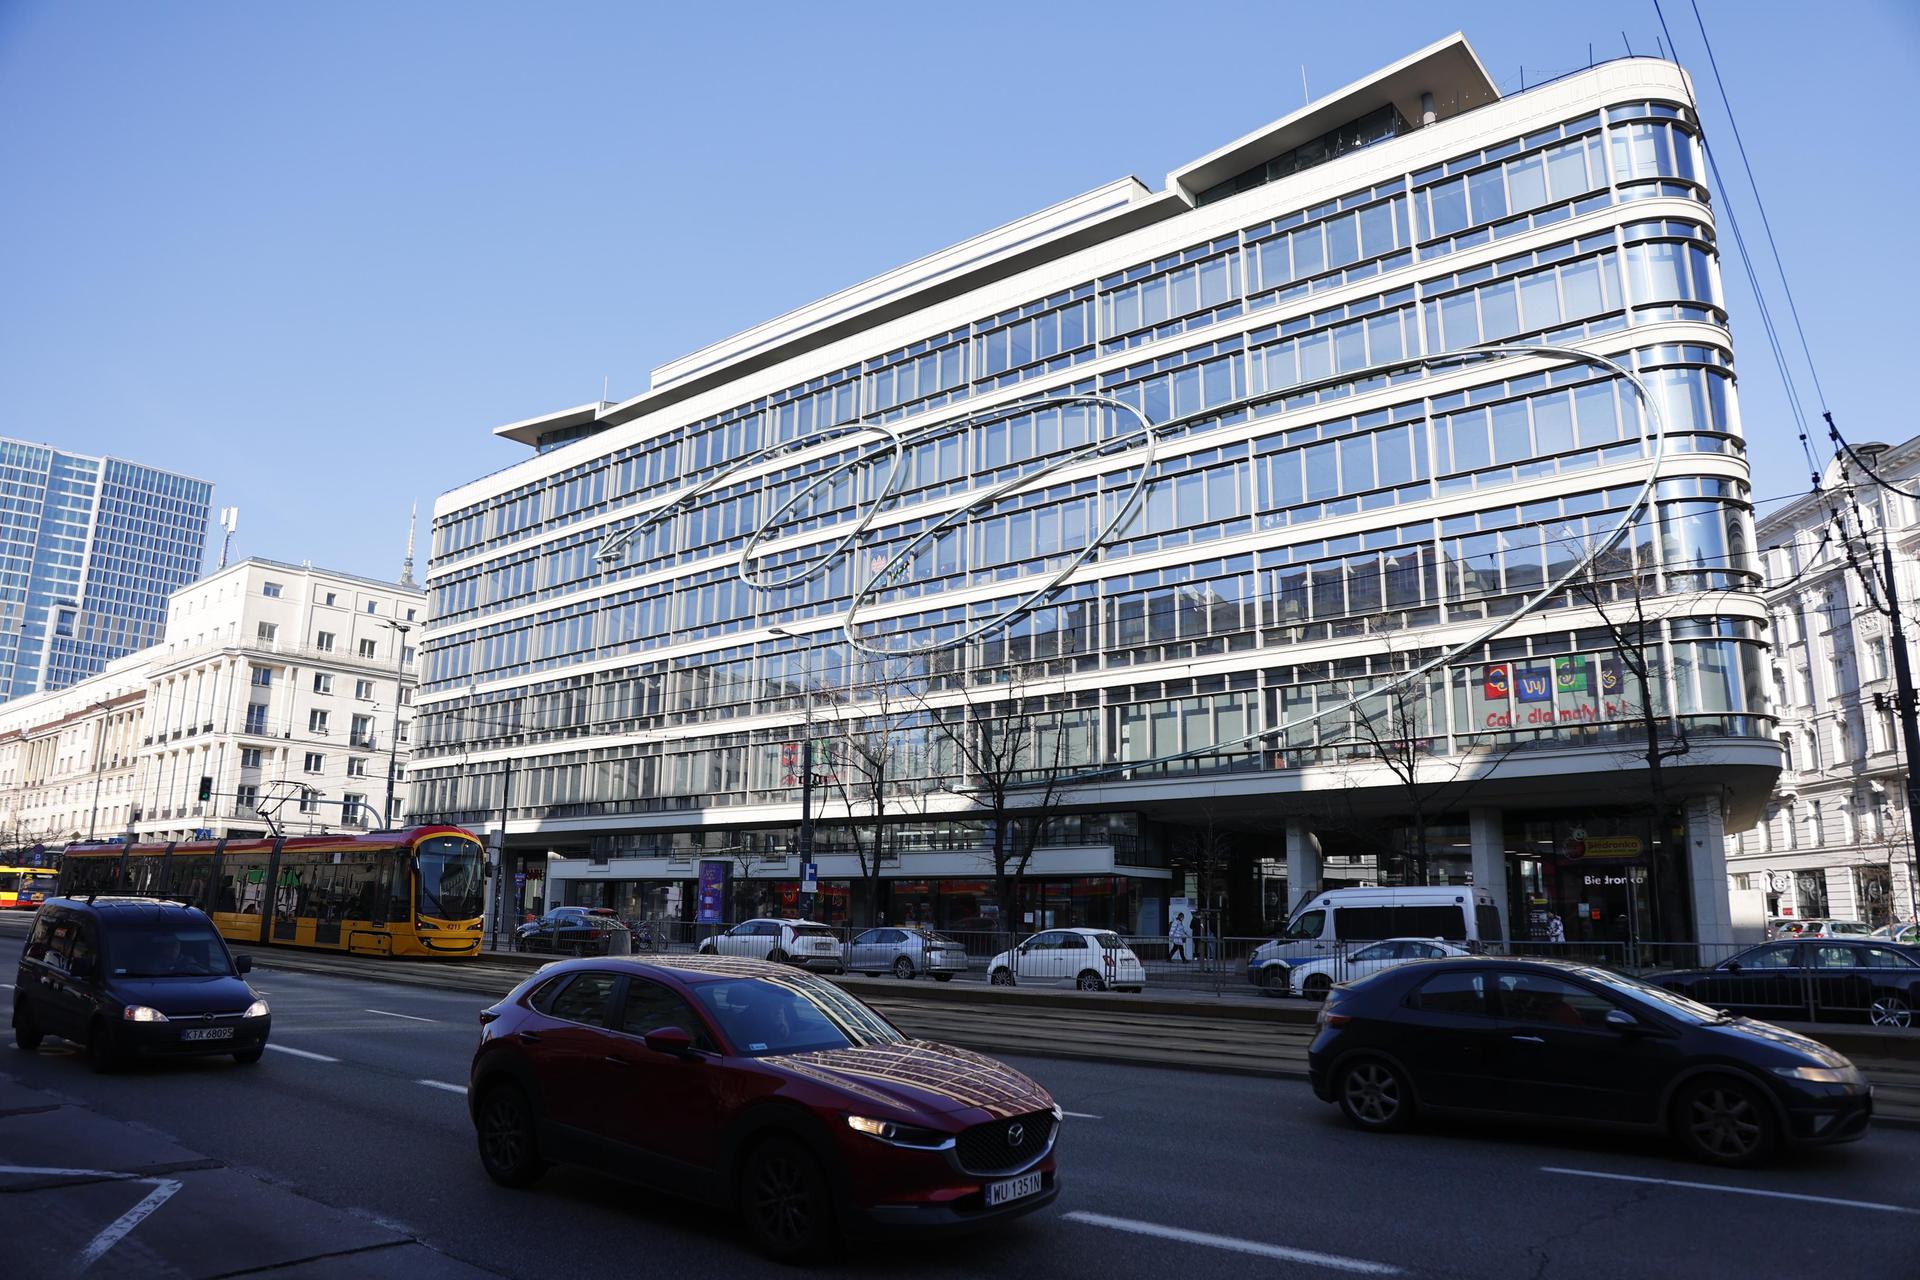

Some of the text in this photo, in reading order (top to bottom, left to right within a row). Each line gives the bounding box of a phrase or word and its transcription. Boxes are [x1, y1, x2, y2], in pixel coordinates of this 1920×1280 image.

[186, 1030, 204, 1039] KTA
[993, 1173, 1040, 1203] WU 1351N
